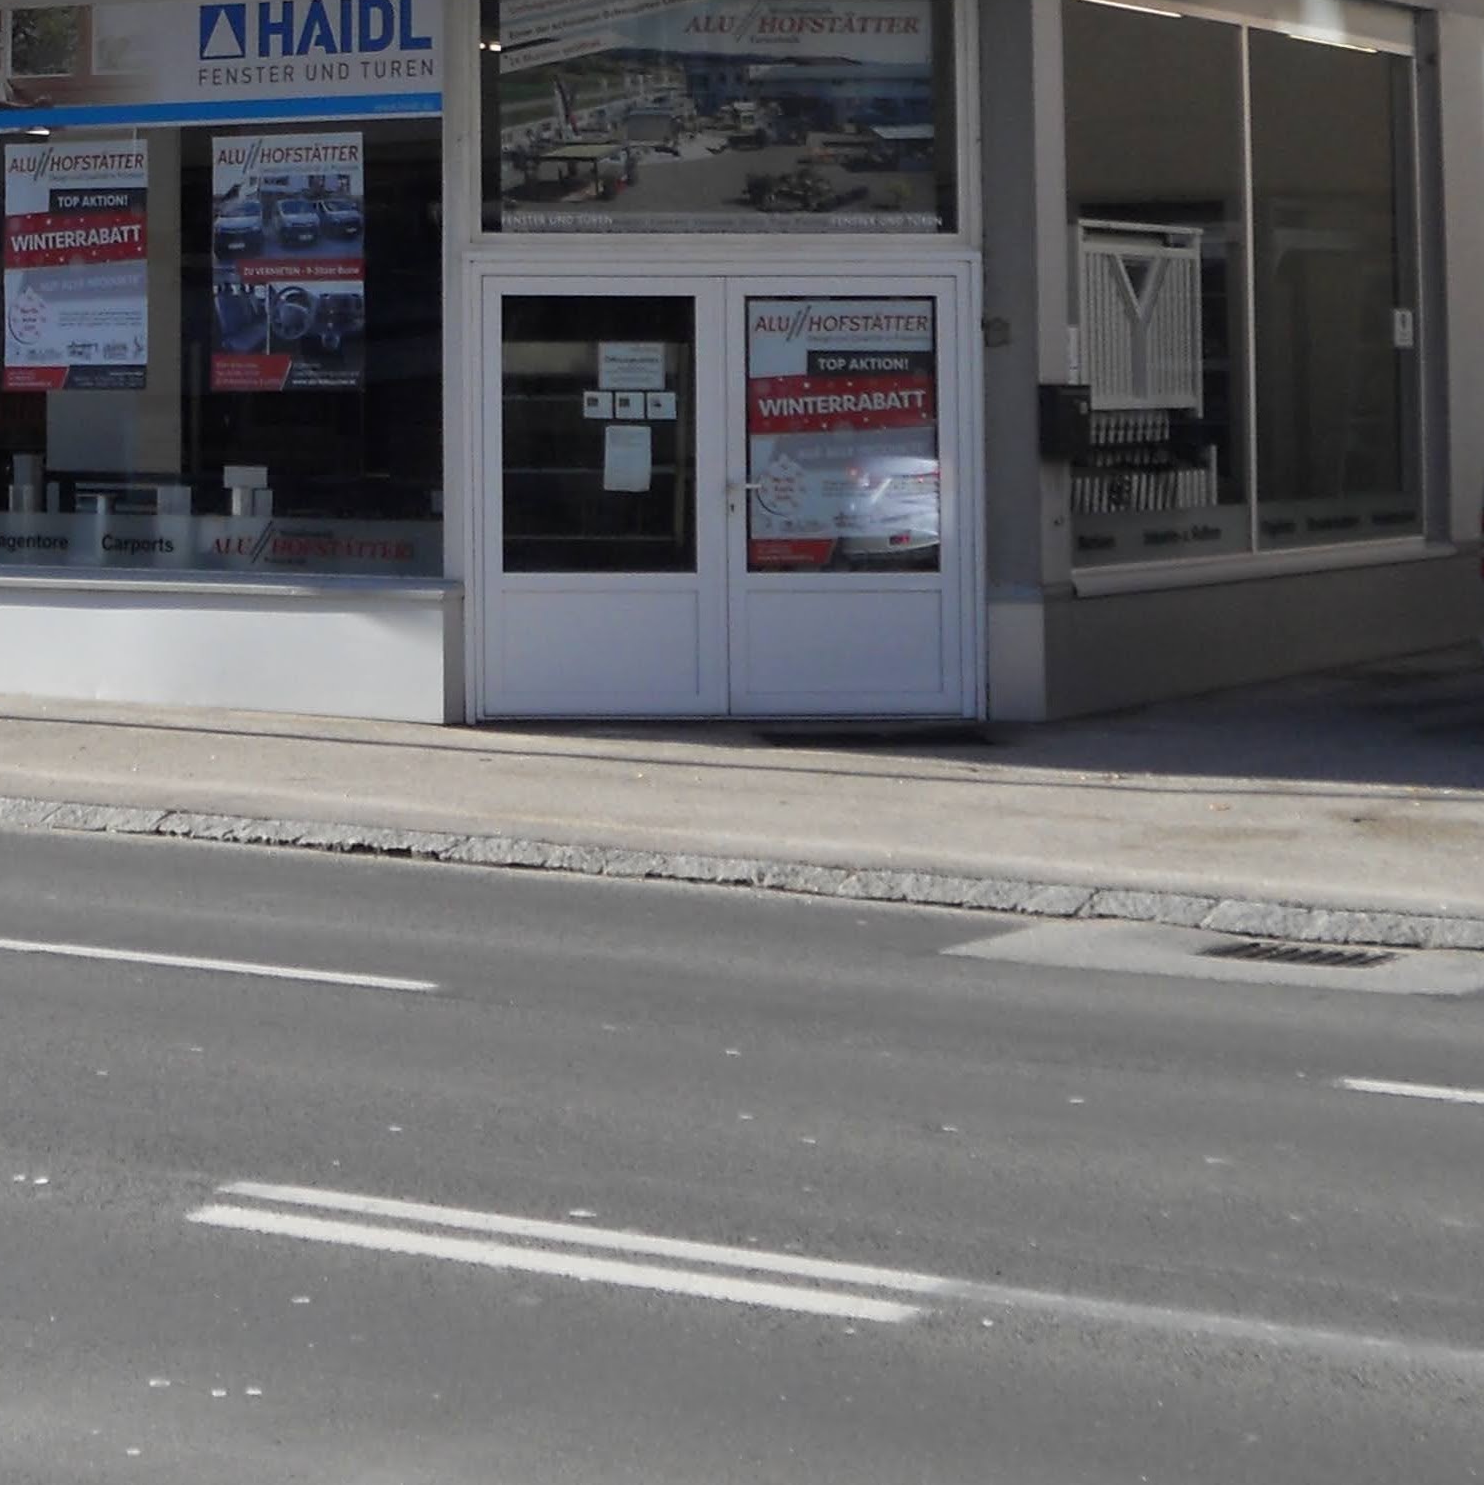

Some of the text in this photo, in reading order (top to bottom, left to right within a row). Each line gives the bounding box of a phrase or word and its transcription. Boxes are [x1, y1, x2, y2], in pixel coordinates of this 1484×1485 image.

[199, 65, 294, 87] FENSTER
[305, 63, 349, 82] UND
[218, 149, 245, 165] ALU
[9, 158, 36, 173] ALU
[58, 194, 128, 208] TOP AKTION!
[11, 225, 143, 253] WINTERRABATT
[755, 317, 789, 332] ALU
[818, 358, 909, 371] TOP AKTION!
[758, 391, 925, 418] WINTERRABATT
[101, 533, 174, 555] Carports
